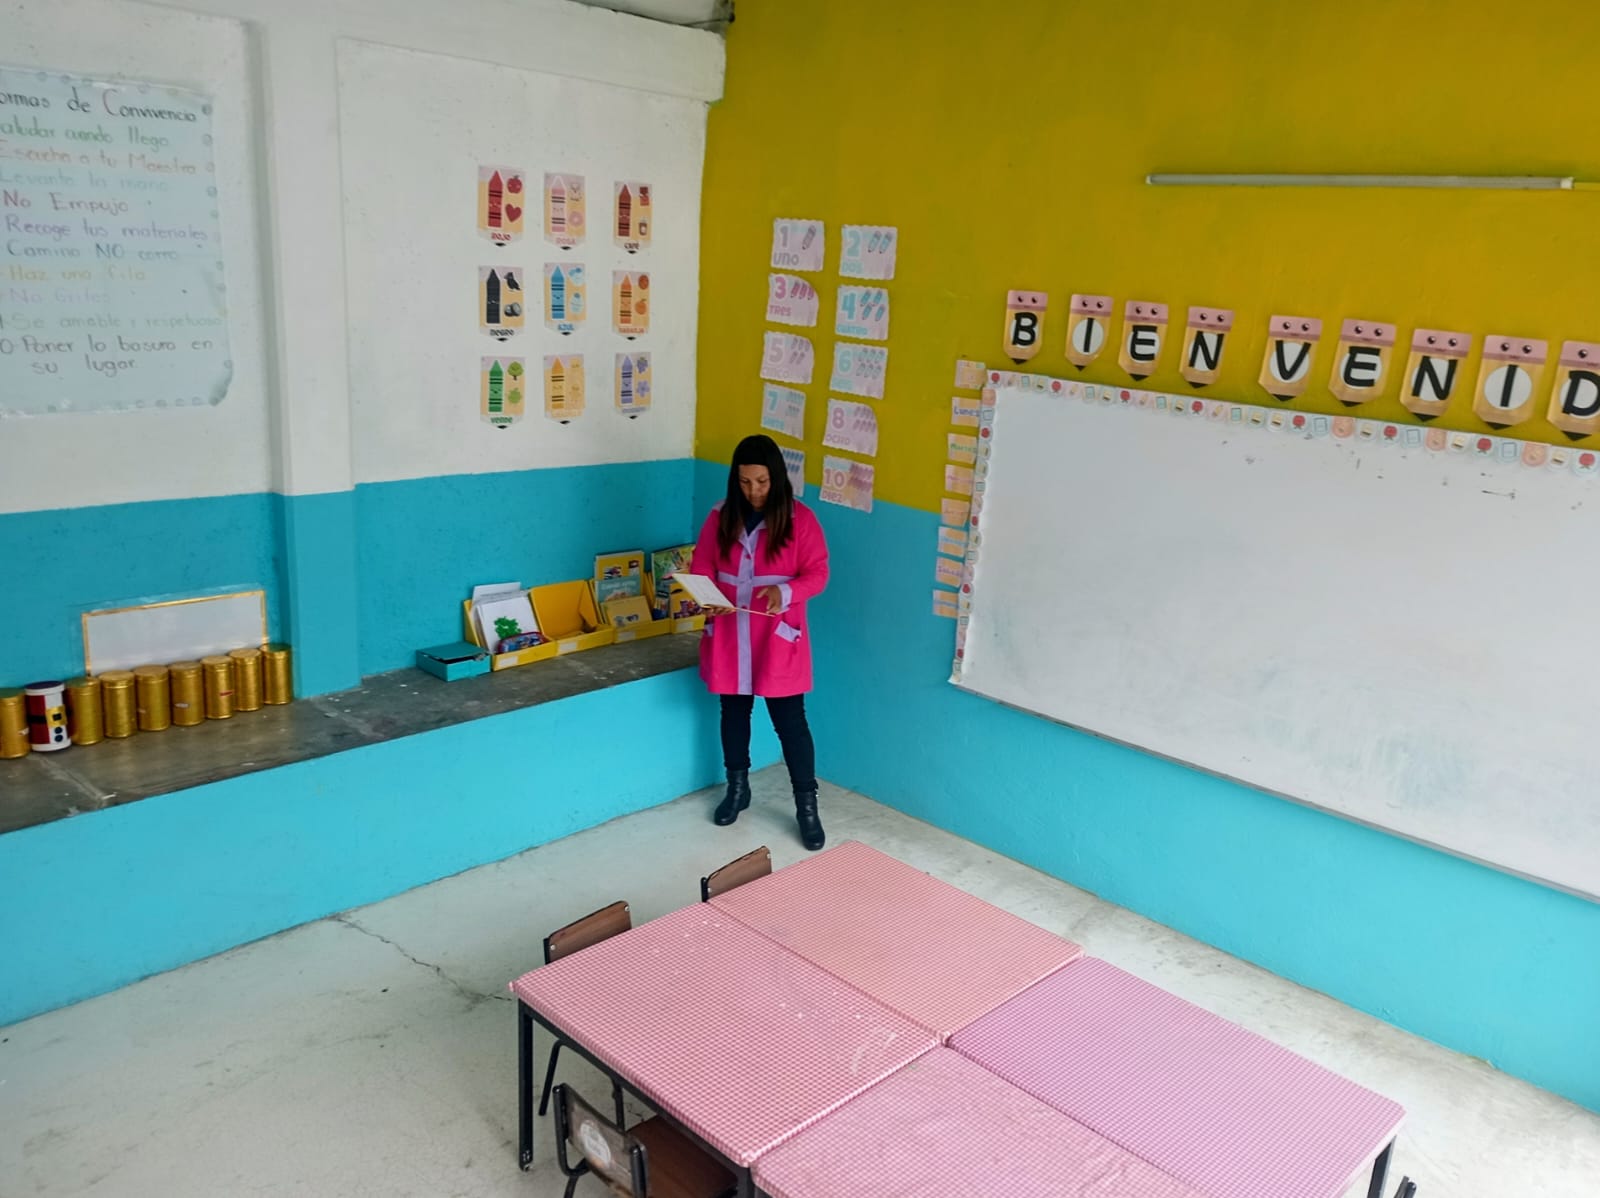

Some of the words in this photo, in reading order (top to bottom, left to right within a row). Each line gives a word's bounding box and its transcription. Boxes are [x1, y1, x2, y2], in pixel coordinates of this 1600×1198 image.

[67, 86, 92, 113] de
[128, 125, 169, 153] llego
[3, 190, 31, 208] No
[49, 192, 129, 217] Empujo
[5, 214, 71, 242] Recoge
[121, 221, 208, 240] materiales
[780, 226, 789, 247] 1
[95, 243, 125, 260] NO
[847, 230, 861, 257] 2
[775, 276, 786, 299] 3
[842, 292, 856, 320] 4
[22, 335, 75, 353] Poner
[191, 340, 213, 351] en
[769, 338, 783, 363] 5
[31, 361, 59, 375] su
[84, 353, 136, 378] lugar
[838, 350, 852, 373] 6
[768, 390, 778, 411] 7
[832, 407, 844, 429] 8
[824, 468, 845, 488] 10
